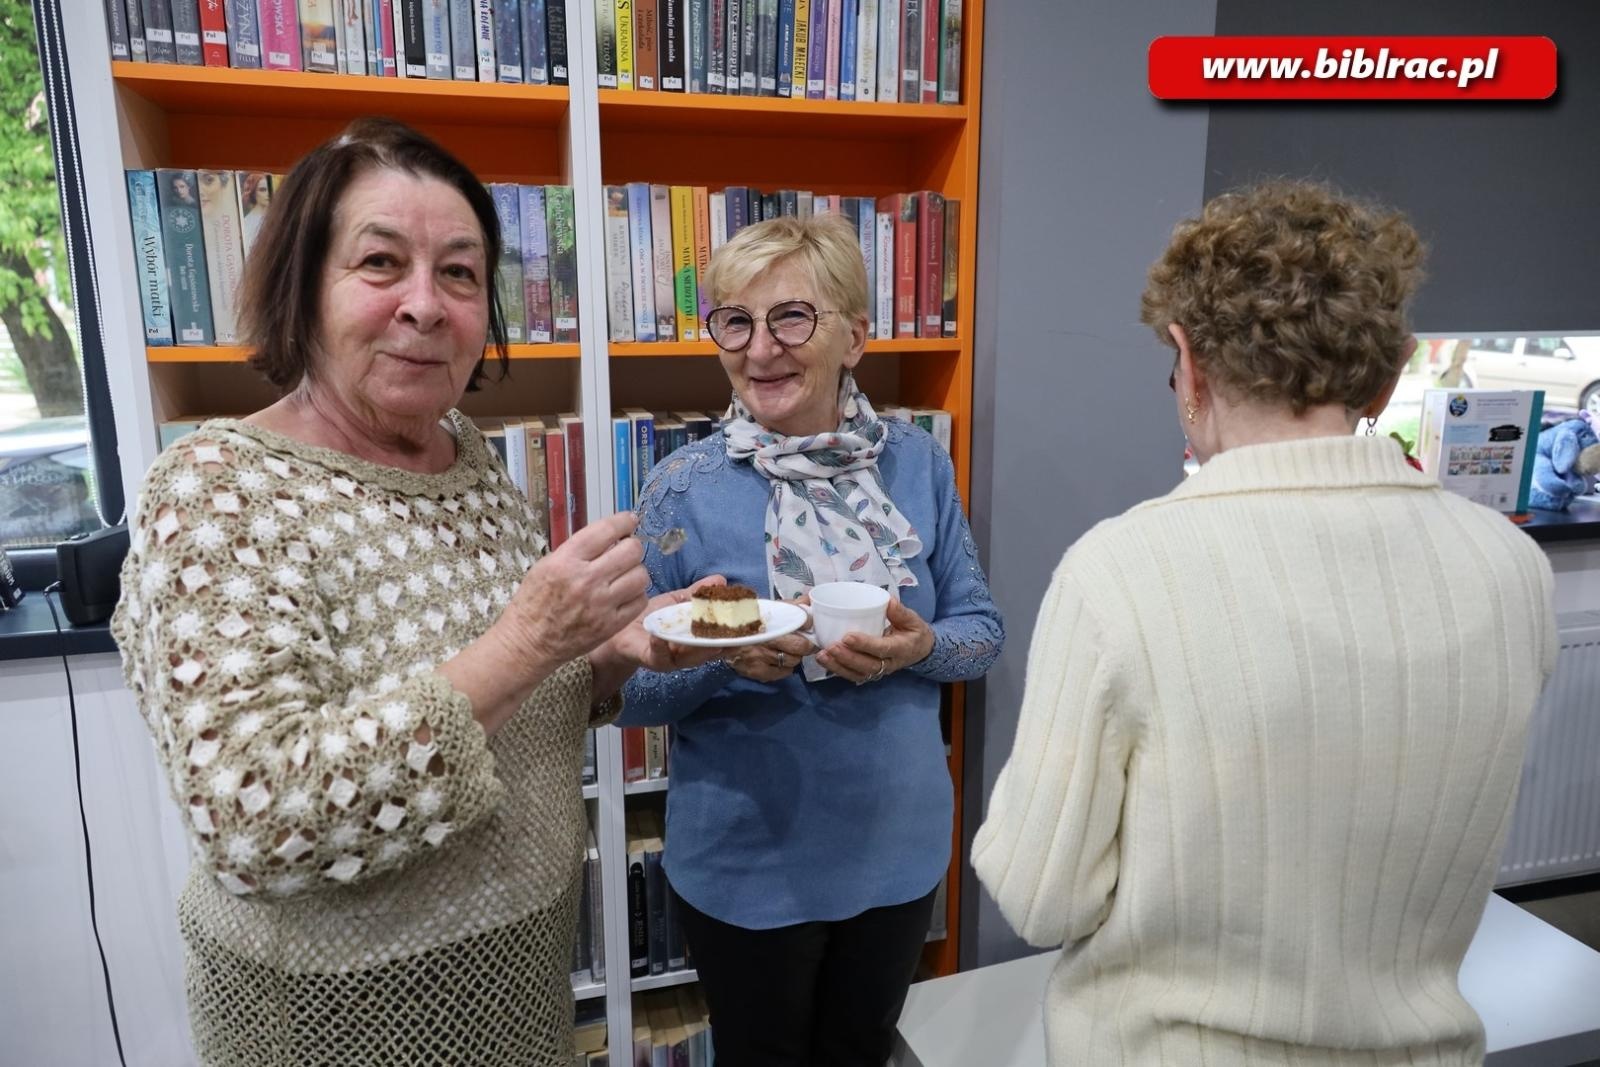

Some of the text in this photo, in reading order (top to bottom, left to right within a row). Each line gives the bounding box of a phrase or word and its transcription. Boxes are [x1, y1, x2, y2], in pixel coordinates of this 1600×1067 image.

[620, 16, 629, 62] UKRAINKA
[142, 235, 159, 277] Wybór
[150, 280, 164, 317] matki
